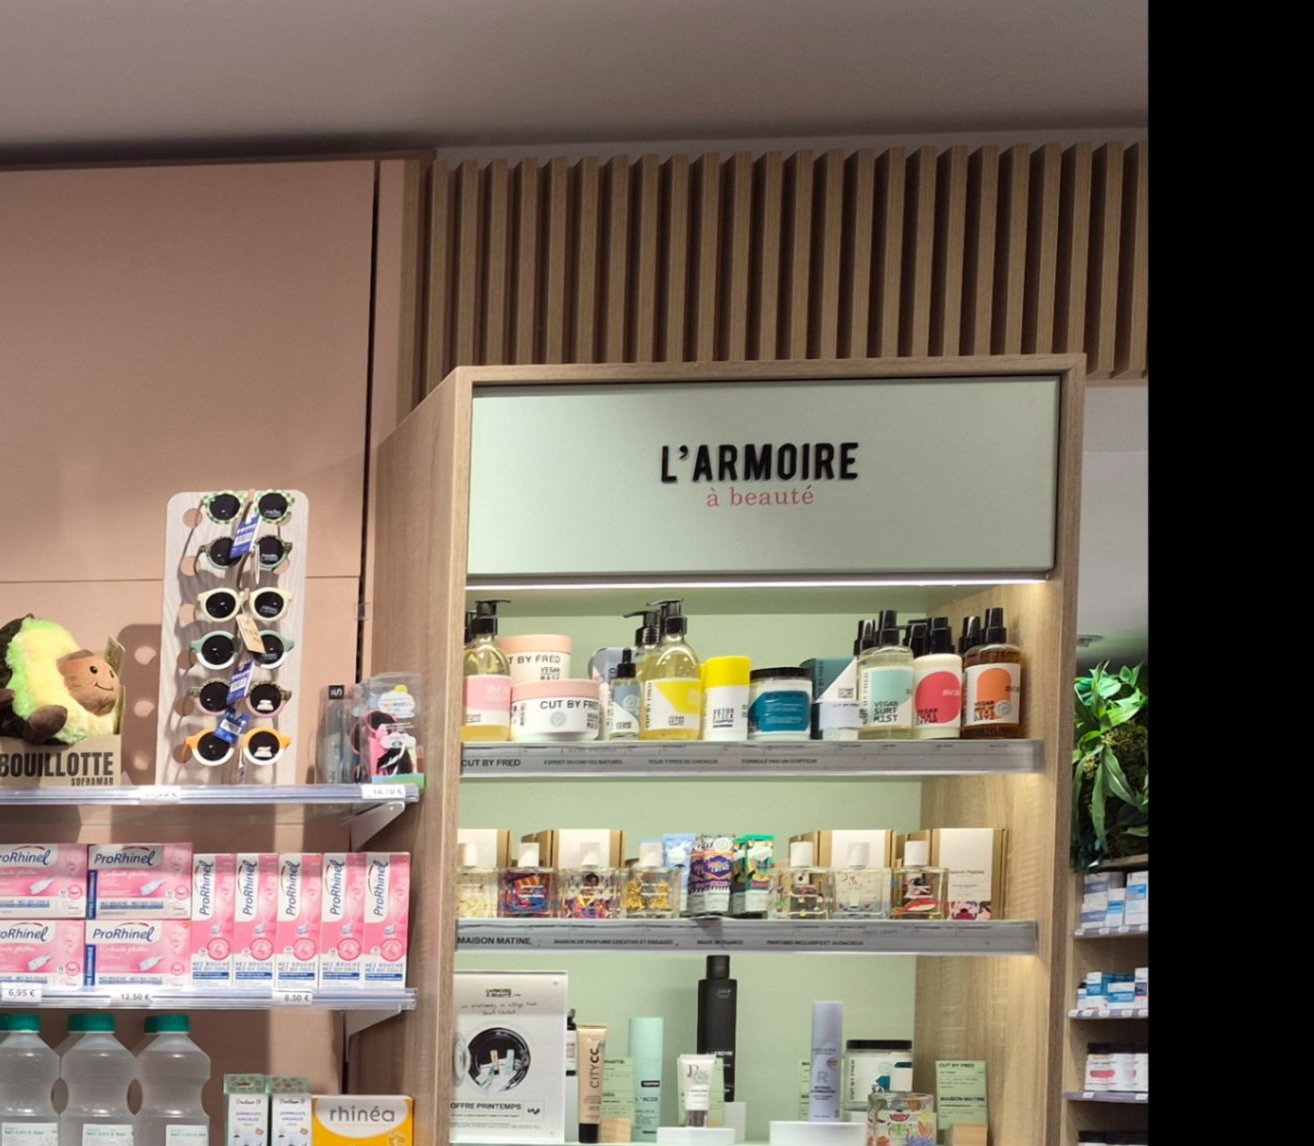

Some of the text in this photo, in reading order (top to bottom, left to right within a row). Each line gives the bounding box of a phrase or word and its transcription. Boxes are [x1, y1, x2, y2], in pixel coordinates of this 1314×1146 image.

[660, 441, 859, 483] L'ARMOIRE
[706, 485, 815, 507] à beauté
[873, 707, 898, 715] SURF
[461, 759, 521, 767] CUT BY FRED
[94, 850, 158, 867] ProRhinel
[199, 860, 214, 916] ProRhinel
[242, 860, 257, 916] ProRhinel
[92, 926, 157, 943] ProRhinel
[329, 1104, 395, 1124] rhinéa
